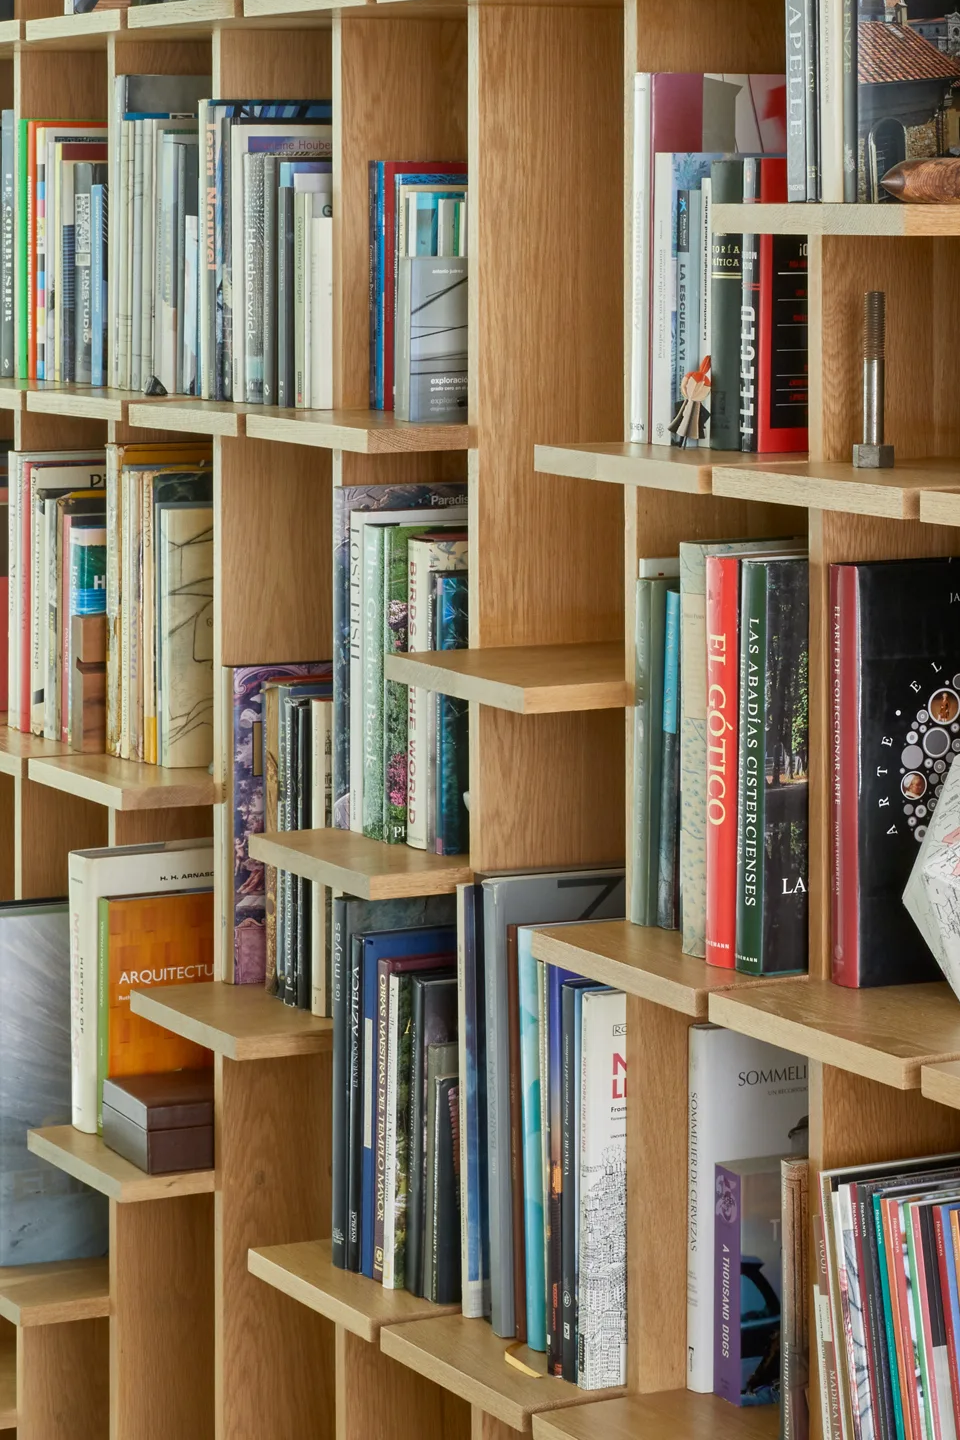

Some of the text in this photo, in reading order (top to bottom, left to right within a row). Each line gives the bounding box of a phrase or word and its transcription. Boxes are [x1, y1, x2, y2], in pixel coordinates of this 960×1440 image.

[206, 187, 217, 271] Nouvel
[679, 263, 686, 281] LA
[247, 228, 257, 340] Heatherwick
[739, 305, 756, 435] FLEECED
[364, 539, 377, 770] The Garden Book
[408, 560, 417, 825] BIRDS WORLD
[707, 632, 733, 826] EL GÓTICO
[744, 618, 760, 907] LAS ABADÍAS CISTERCIENSES
[782, 877, 807, 895] LA
[119, 963, 214, 985] ARQUITECTU
[334, 921, 342, 978] mayas
[352, 966, 360, 1038] AZTECA
[722, 1257, 730, 1359] THOUSAND DOGS
[829, 1370, 838, 1412] MADERA
